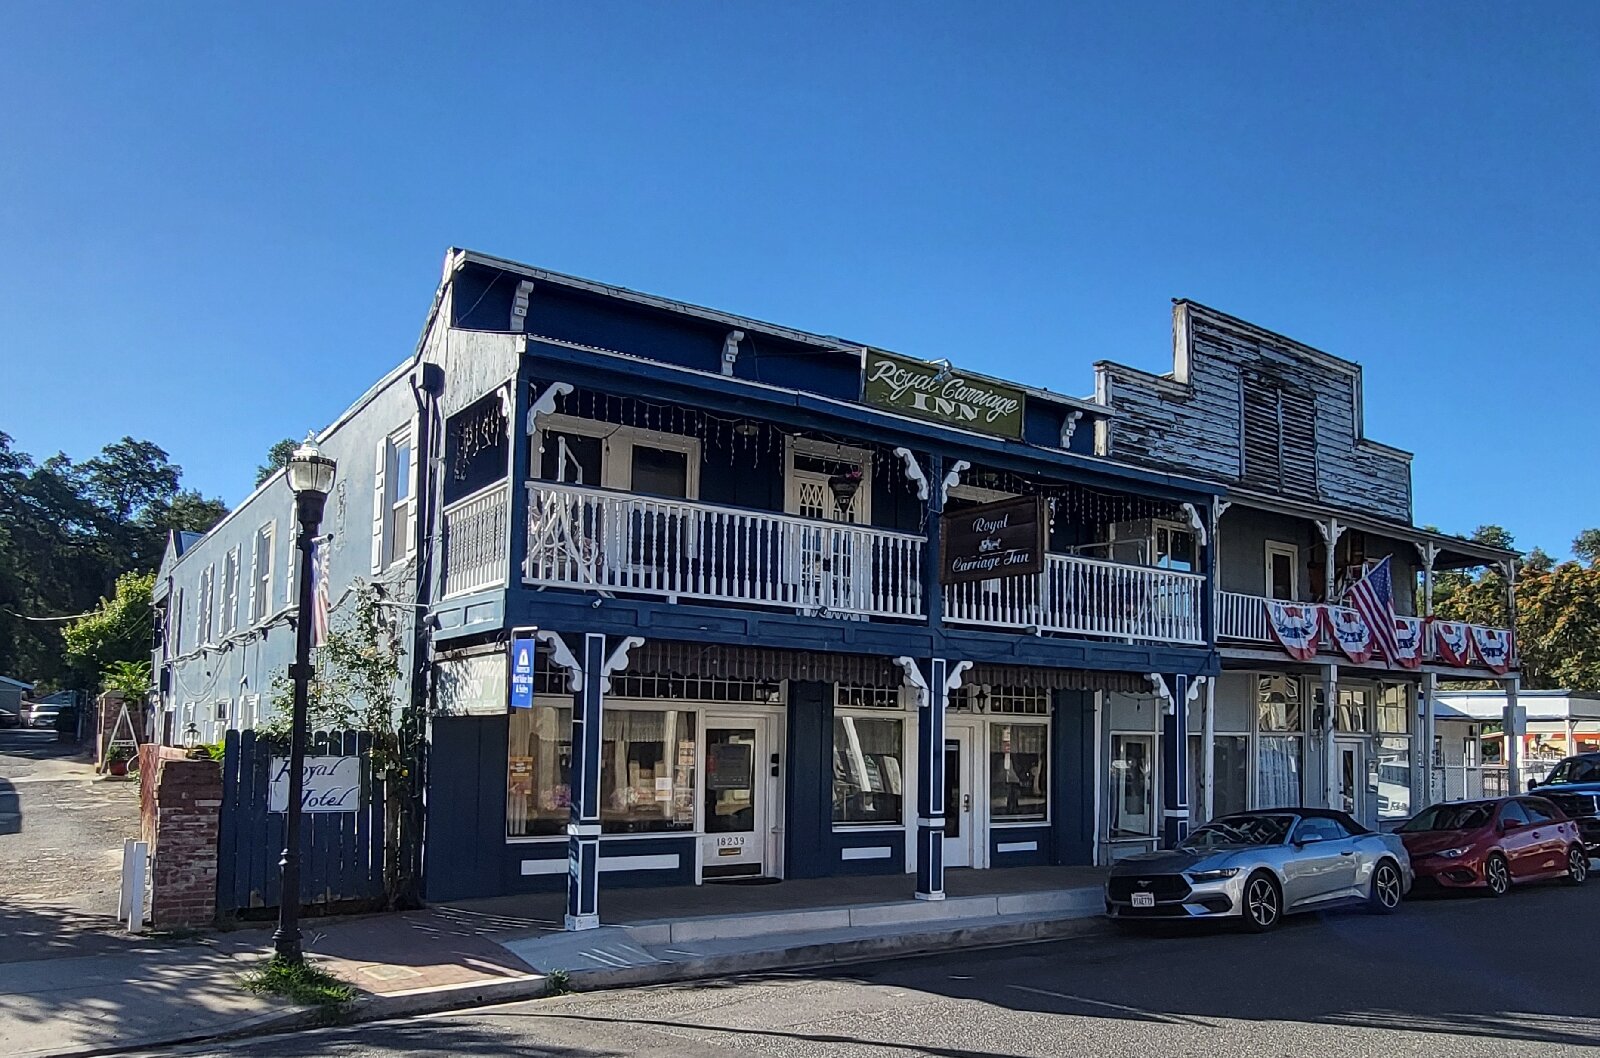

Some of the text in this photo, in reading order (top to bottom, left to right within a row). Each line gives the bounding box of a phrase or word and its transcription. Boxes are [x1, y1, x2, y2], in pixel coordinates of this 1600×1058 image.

[868, 360, 1019, 423] Royal Carriage
[972, 513, 1009, 534] Royal
[952, 549, 1030, 573] Carriage Inn
[716, 836, 745, 847] 18239
